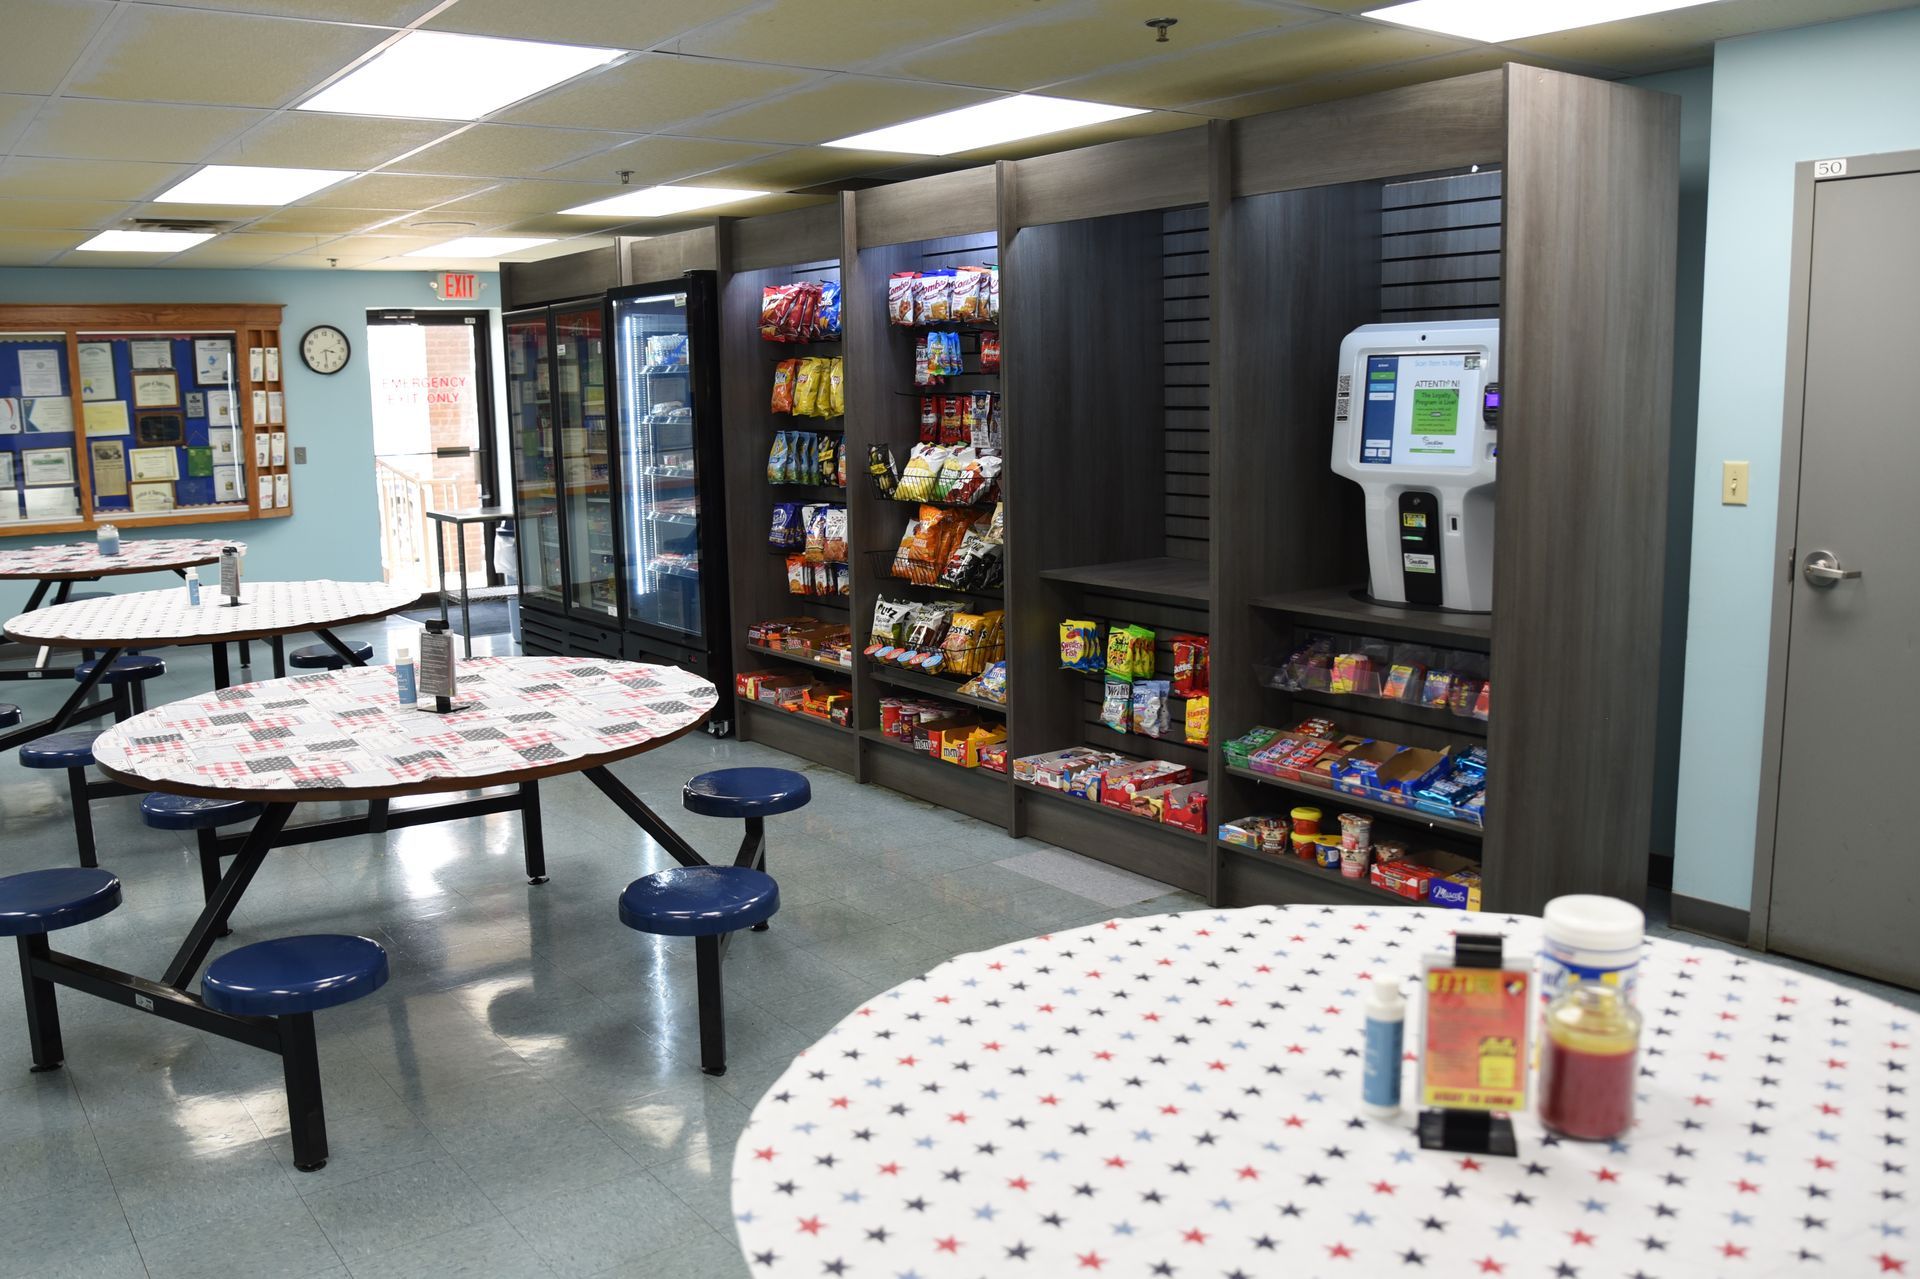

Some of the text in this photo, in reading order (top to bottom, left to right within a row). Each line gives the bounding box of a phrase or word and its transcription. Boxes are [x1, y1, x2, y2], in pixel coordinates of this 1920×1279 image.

[1819, 161, 1842, 175] 50
[445, 273, 475, 298] EXIT
[427, 393, 459, 403] ONLY
[1061, 641, 1083, 651] Swedish
[1065, 649, 1077, 658] Fish
